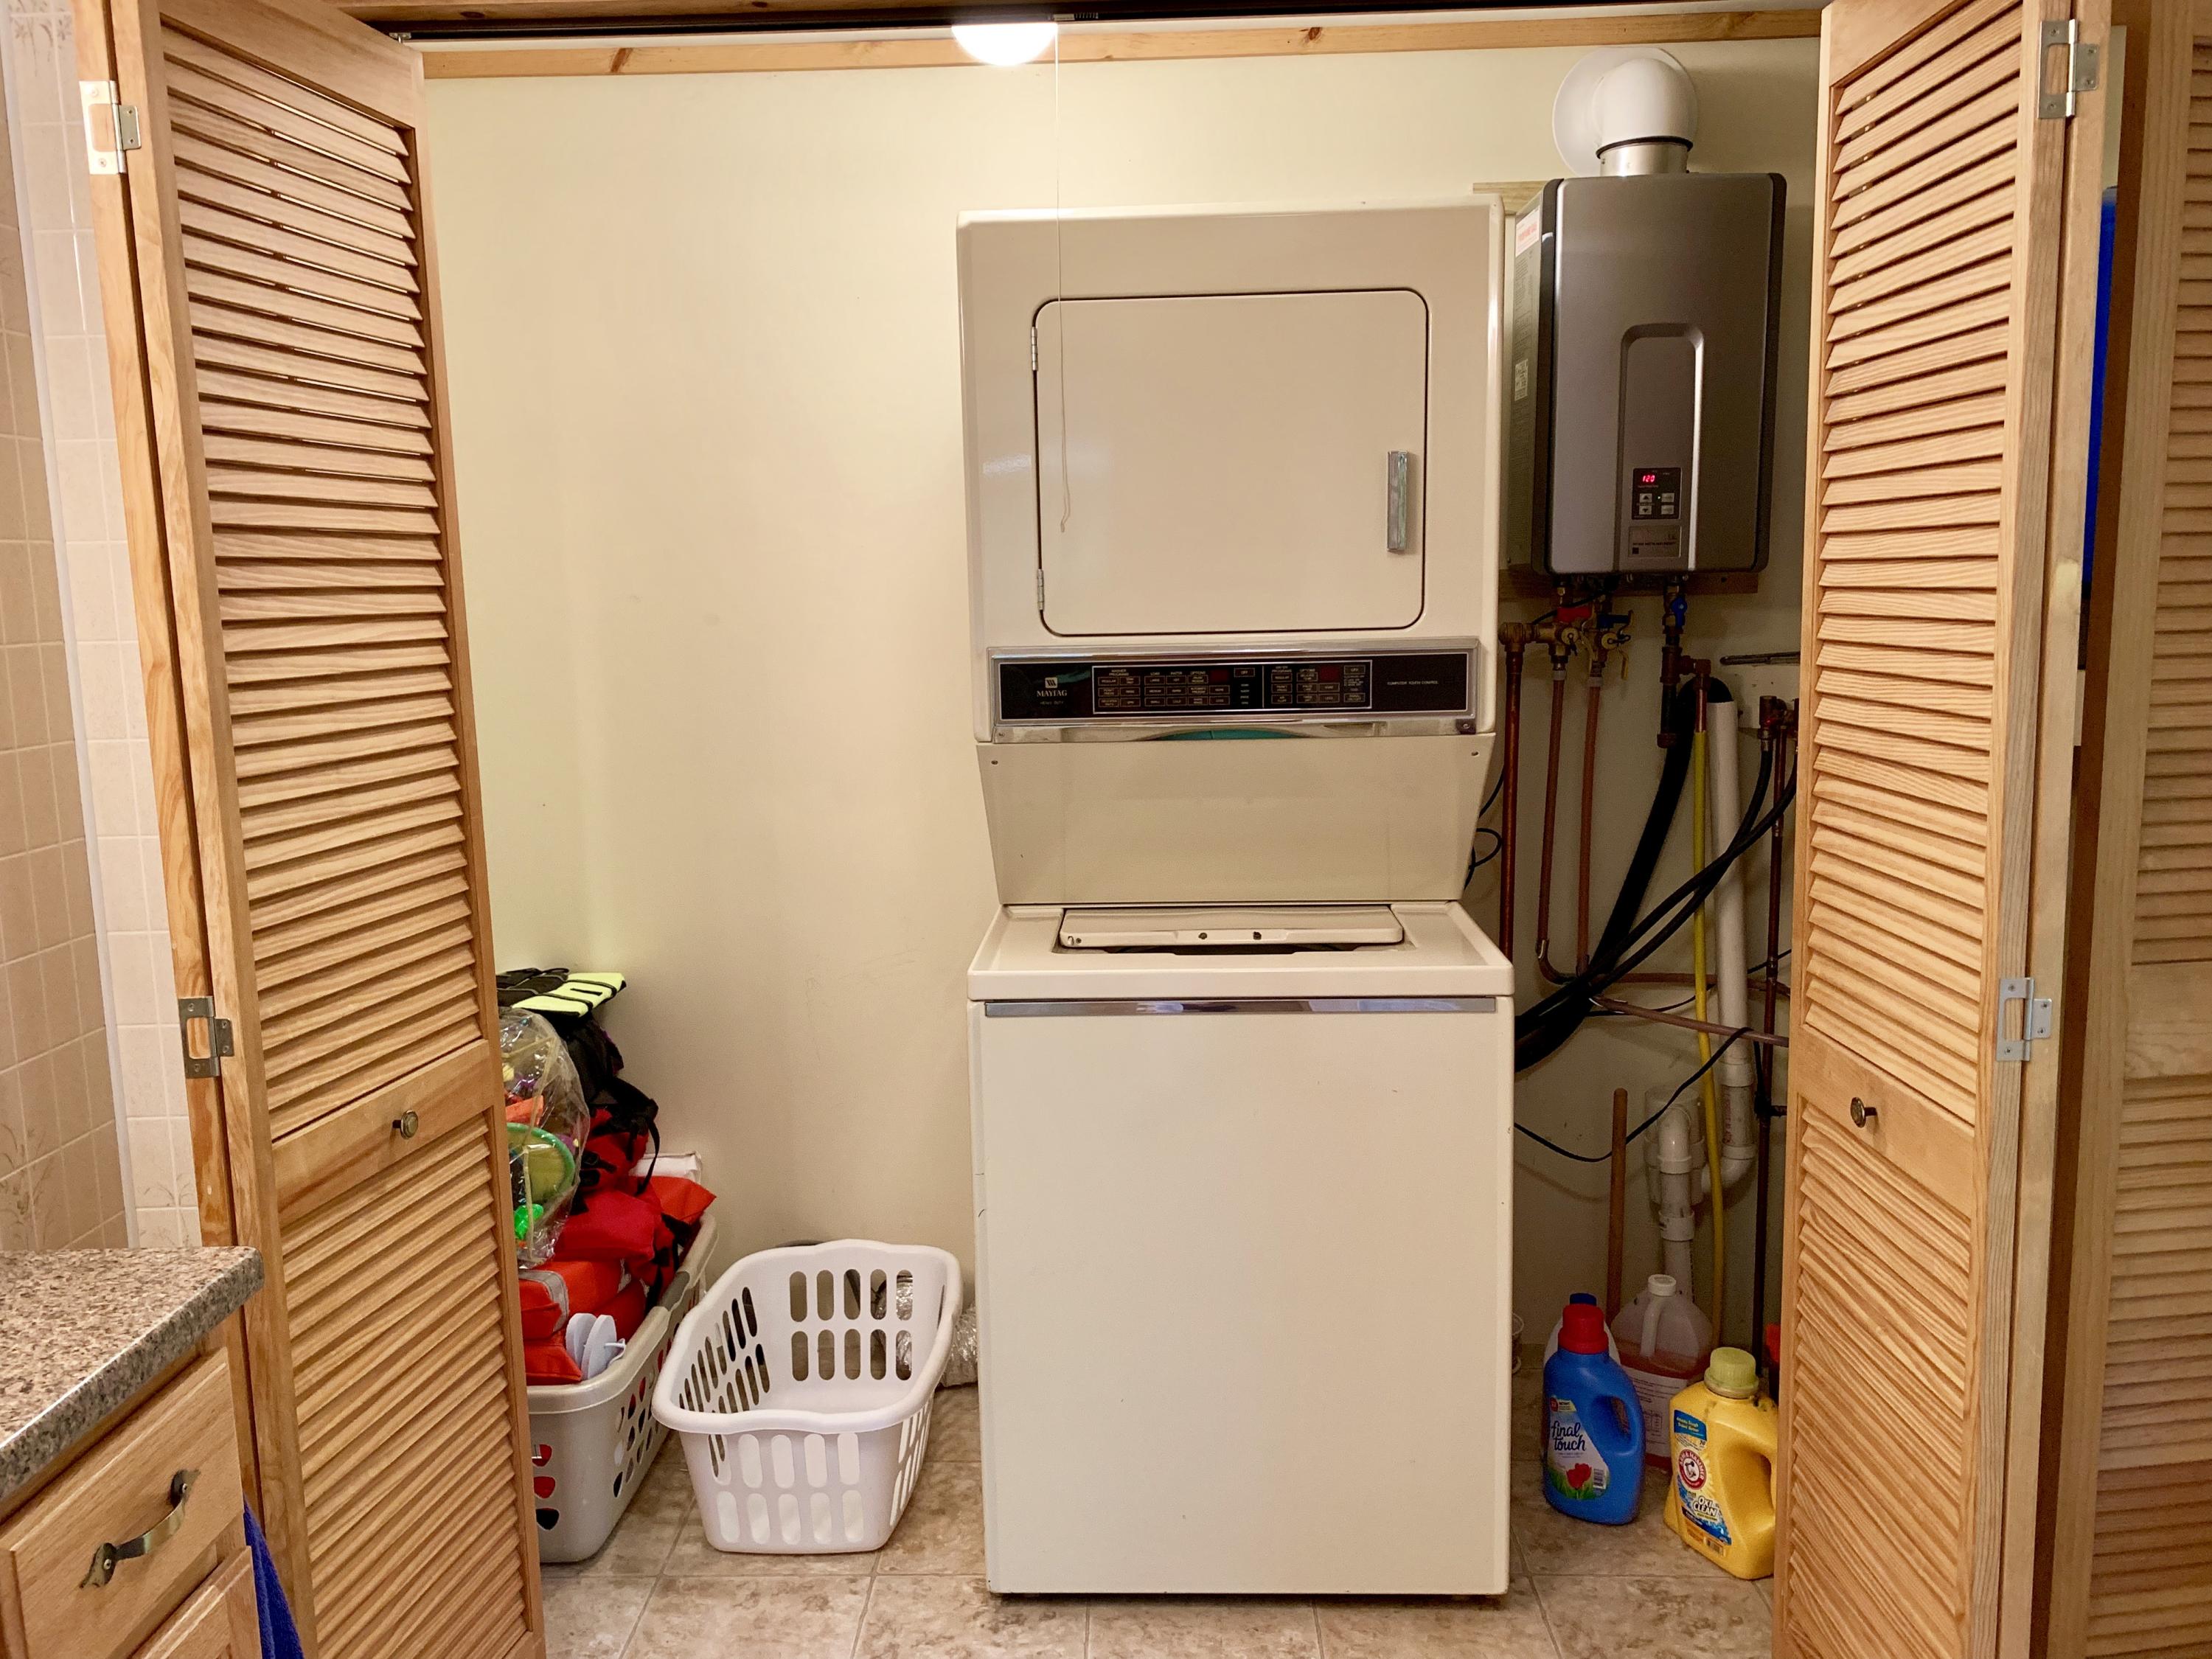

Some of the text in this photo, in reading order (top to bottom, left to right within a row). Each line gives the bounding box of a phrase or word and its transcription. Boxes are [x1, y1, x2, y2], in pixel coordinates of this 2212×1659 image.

[1642, 474, 1655, 483] 120
[1036, 689, 1068, 698] MAYTAG
[1551, 1420, 1581, 1438] final
[1553, 1435, 1585, 1452] touch
[1689, 1452, 1705, 1481] HAMMER
[1693, 1500, 1718, 1517] CLEAN
[1698, 1495, 1713, 1508] OXI
